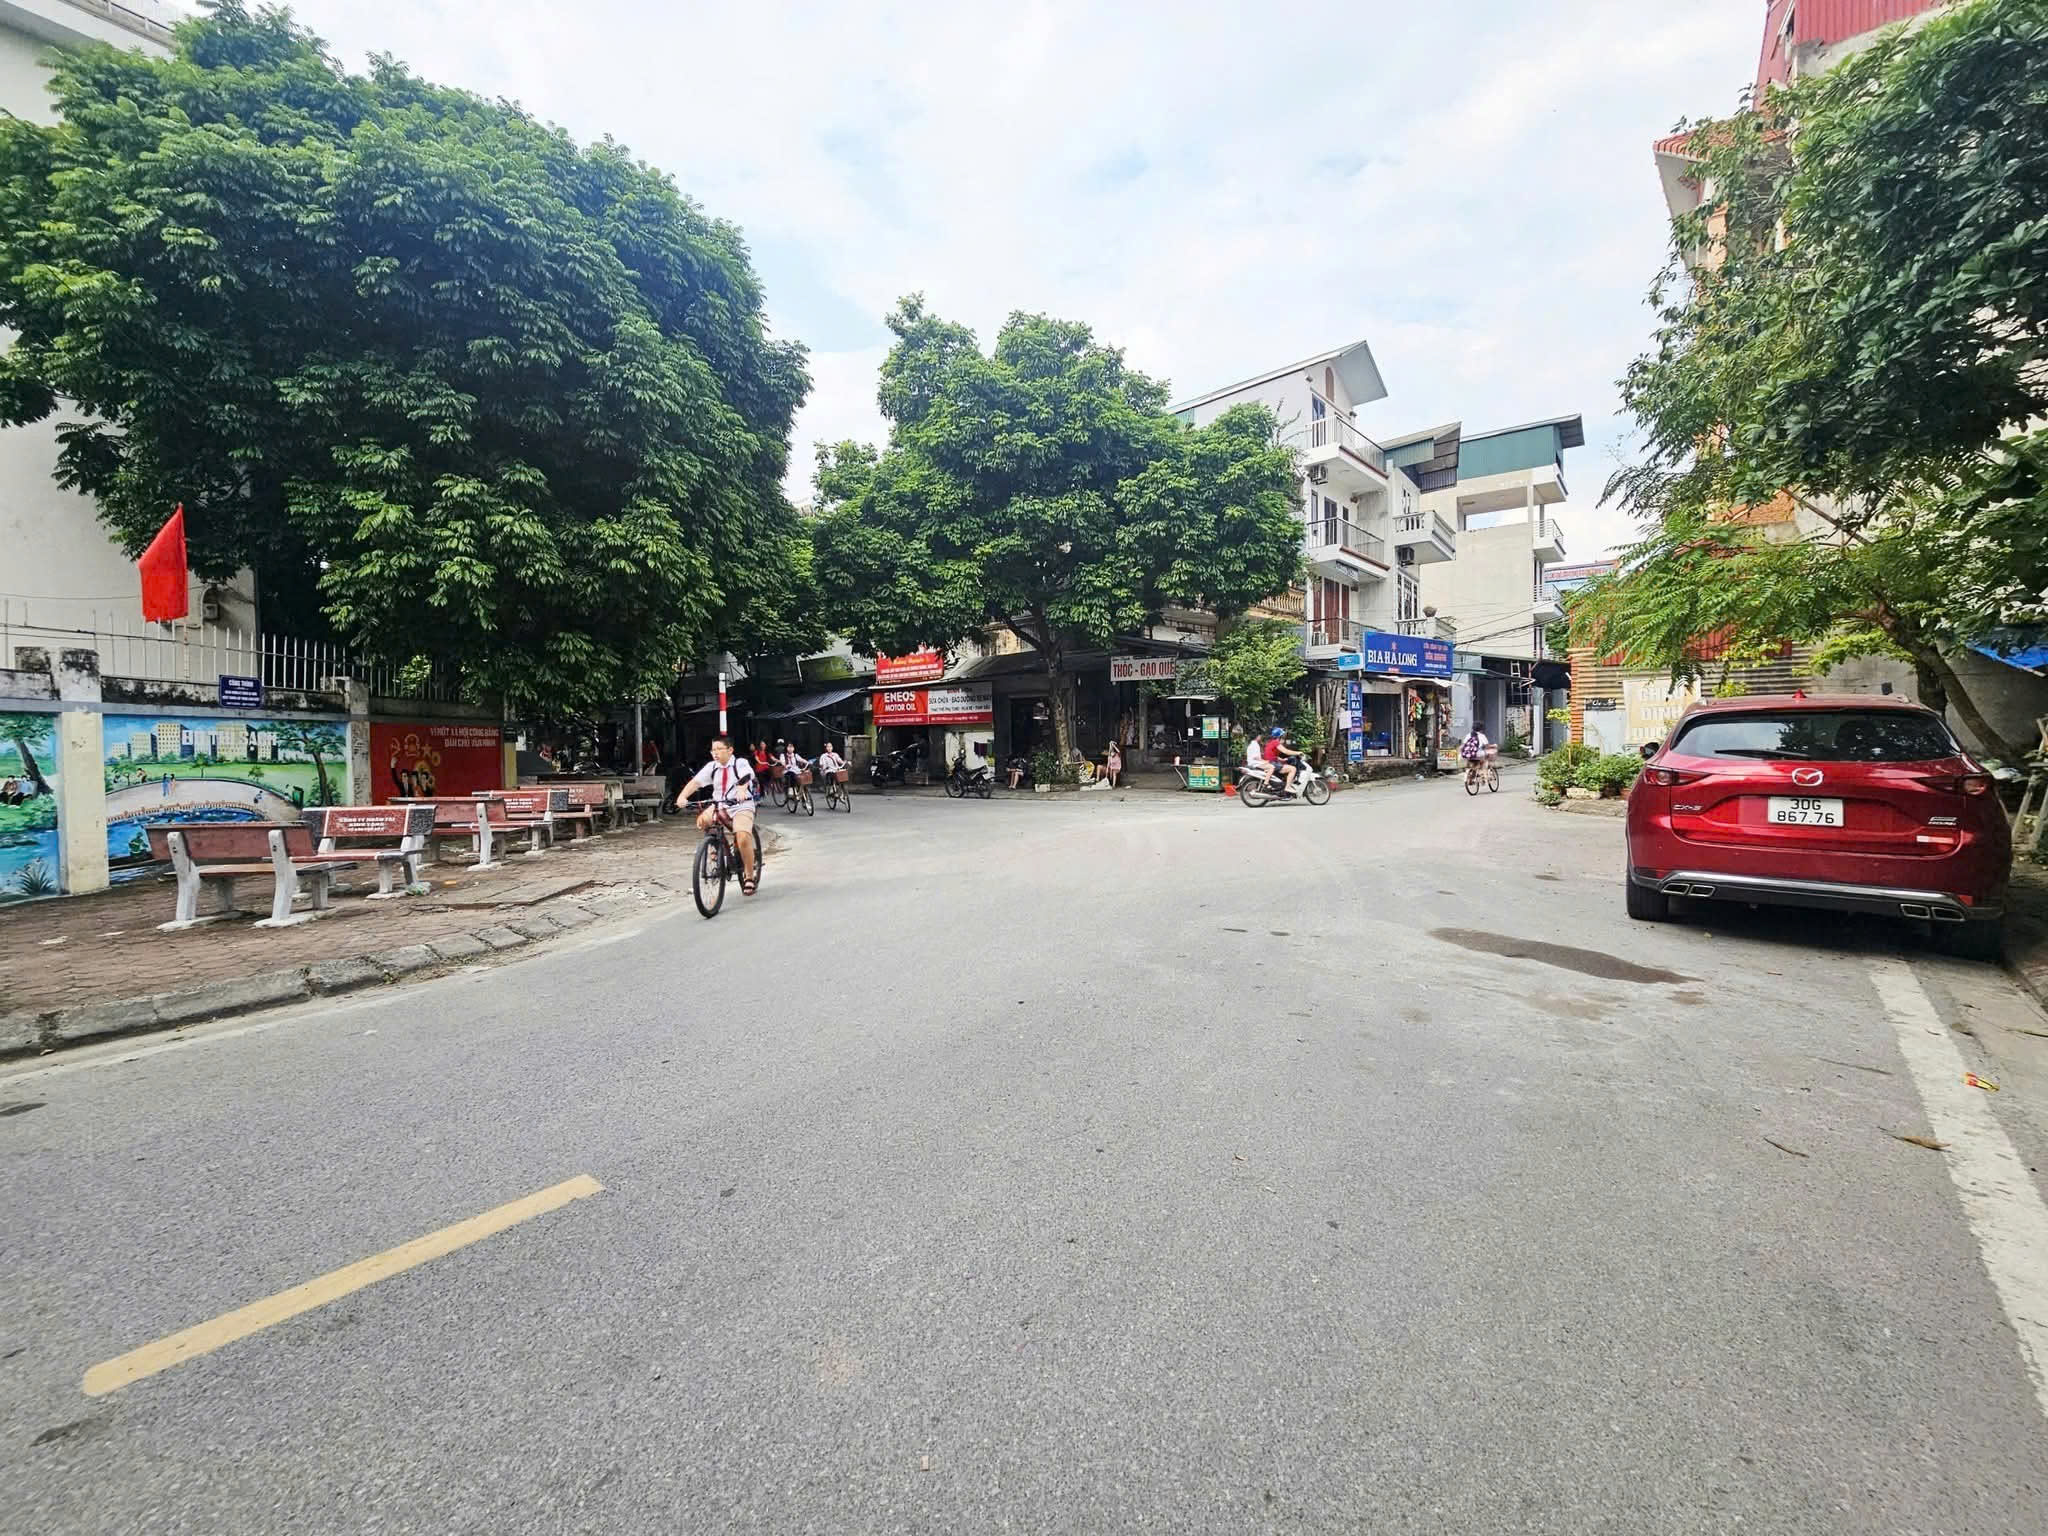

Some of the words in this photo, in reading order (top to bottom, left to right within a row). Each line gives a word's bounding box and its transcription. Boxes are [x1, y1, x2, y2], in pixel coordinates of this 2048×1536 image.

[1368, 649, 1384, 663] BIA
[1398, 652, 1418, 667] LONG
[1113, 661, 1133, 678] THÓC
[1140, 662, 1157, 679] GẠO
[1159, 658, 1175, 676] QUÊ
[884, 691, 916, 703] ENEOS
[885, 703, 906, 711] MOTOR
[906, 702, 916, 711] OIL
[1790, 798, 1822, 811] 30G
[1777, 811, 1835, 824] 867.76
